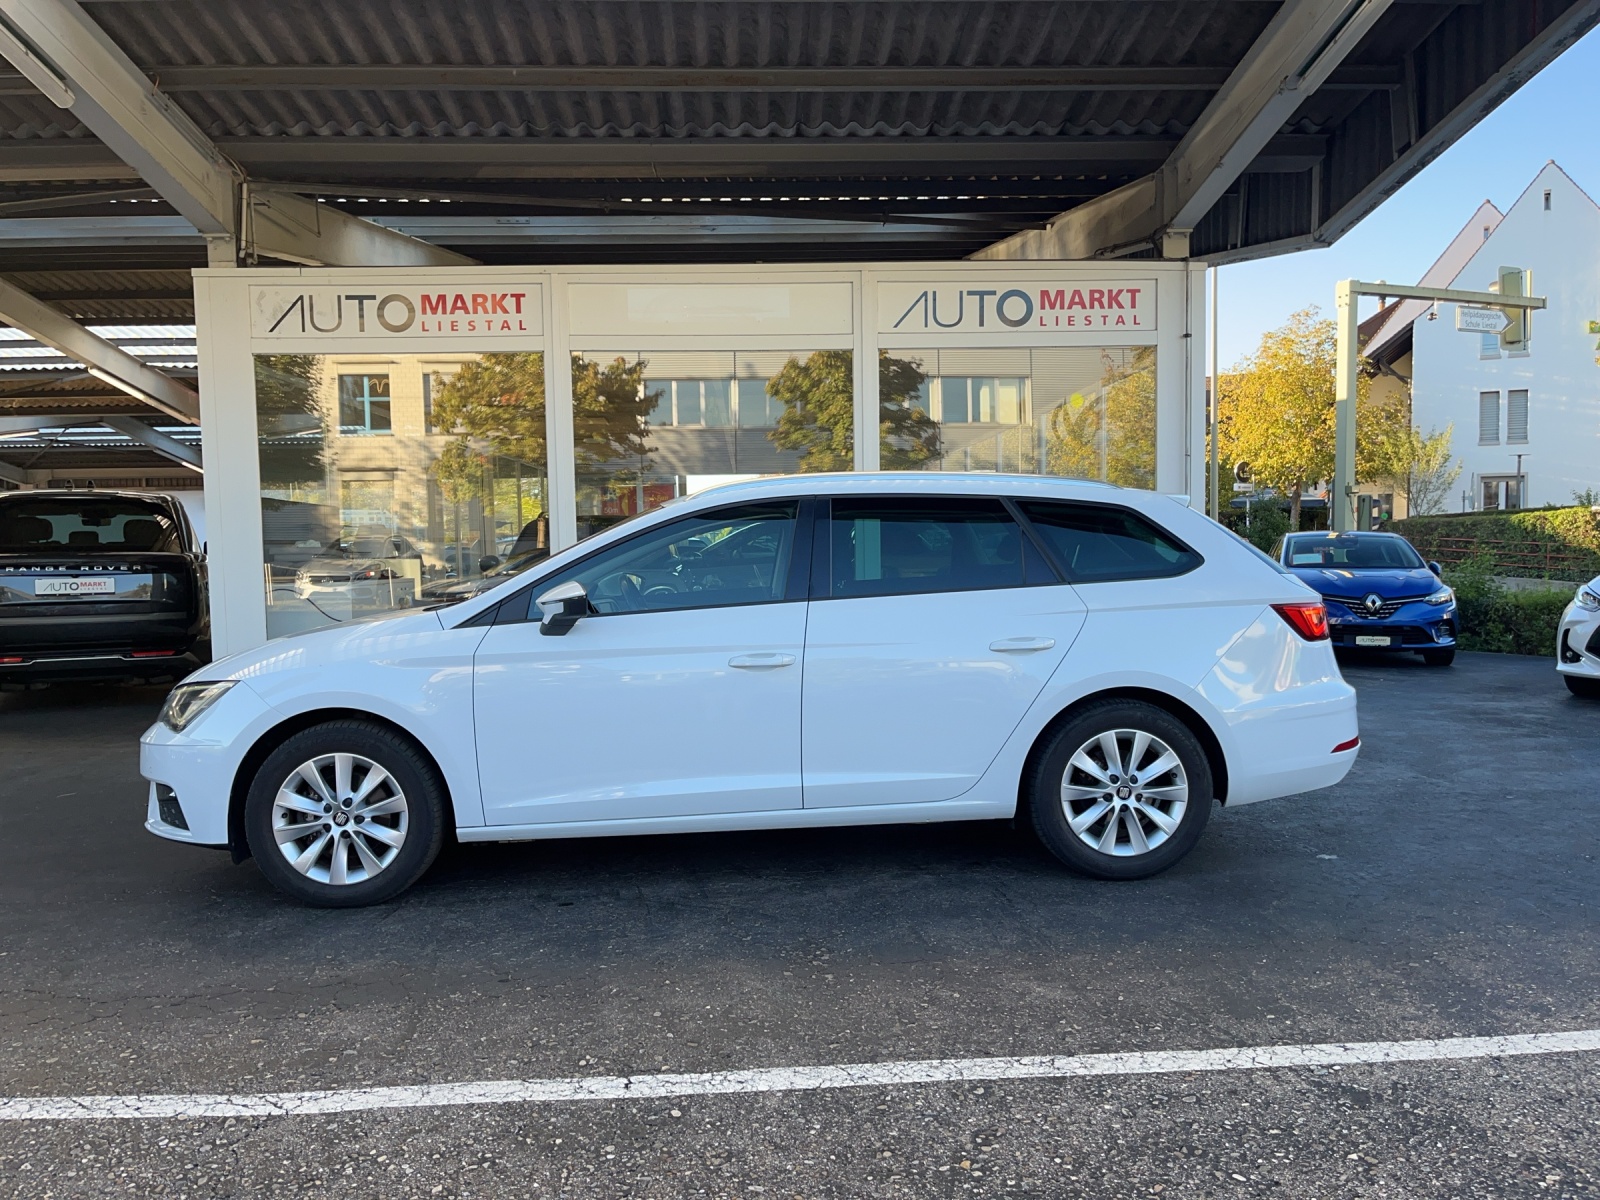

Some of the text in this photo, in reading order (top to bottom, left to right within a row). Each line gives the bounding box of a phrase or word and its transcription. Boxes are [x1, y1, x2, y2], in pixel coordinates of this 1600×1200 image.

[268, 293, 526, 333] AUTO MARKT
[893, 288, 1141, 328] AUTO MARKT
[1039, 314, 1141, 327] LIESTAL
[1460, 310, 1502, 321] Heilpädagogische
[421, 319, 527, 332] LIESTAL
[1465, 320, 1497, 329] Schule Liestal
[43, 582, 80, 592] AUTO
